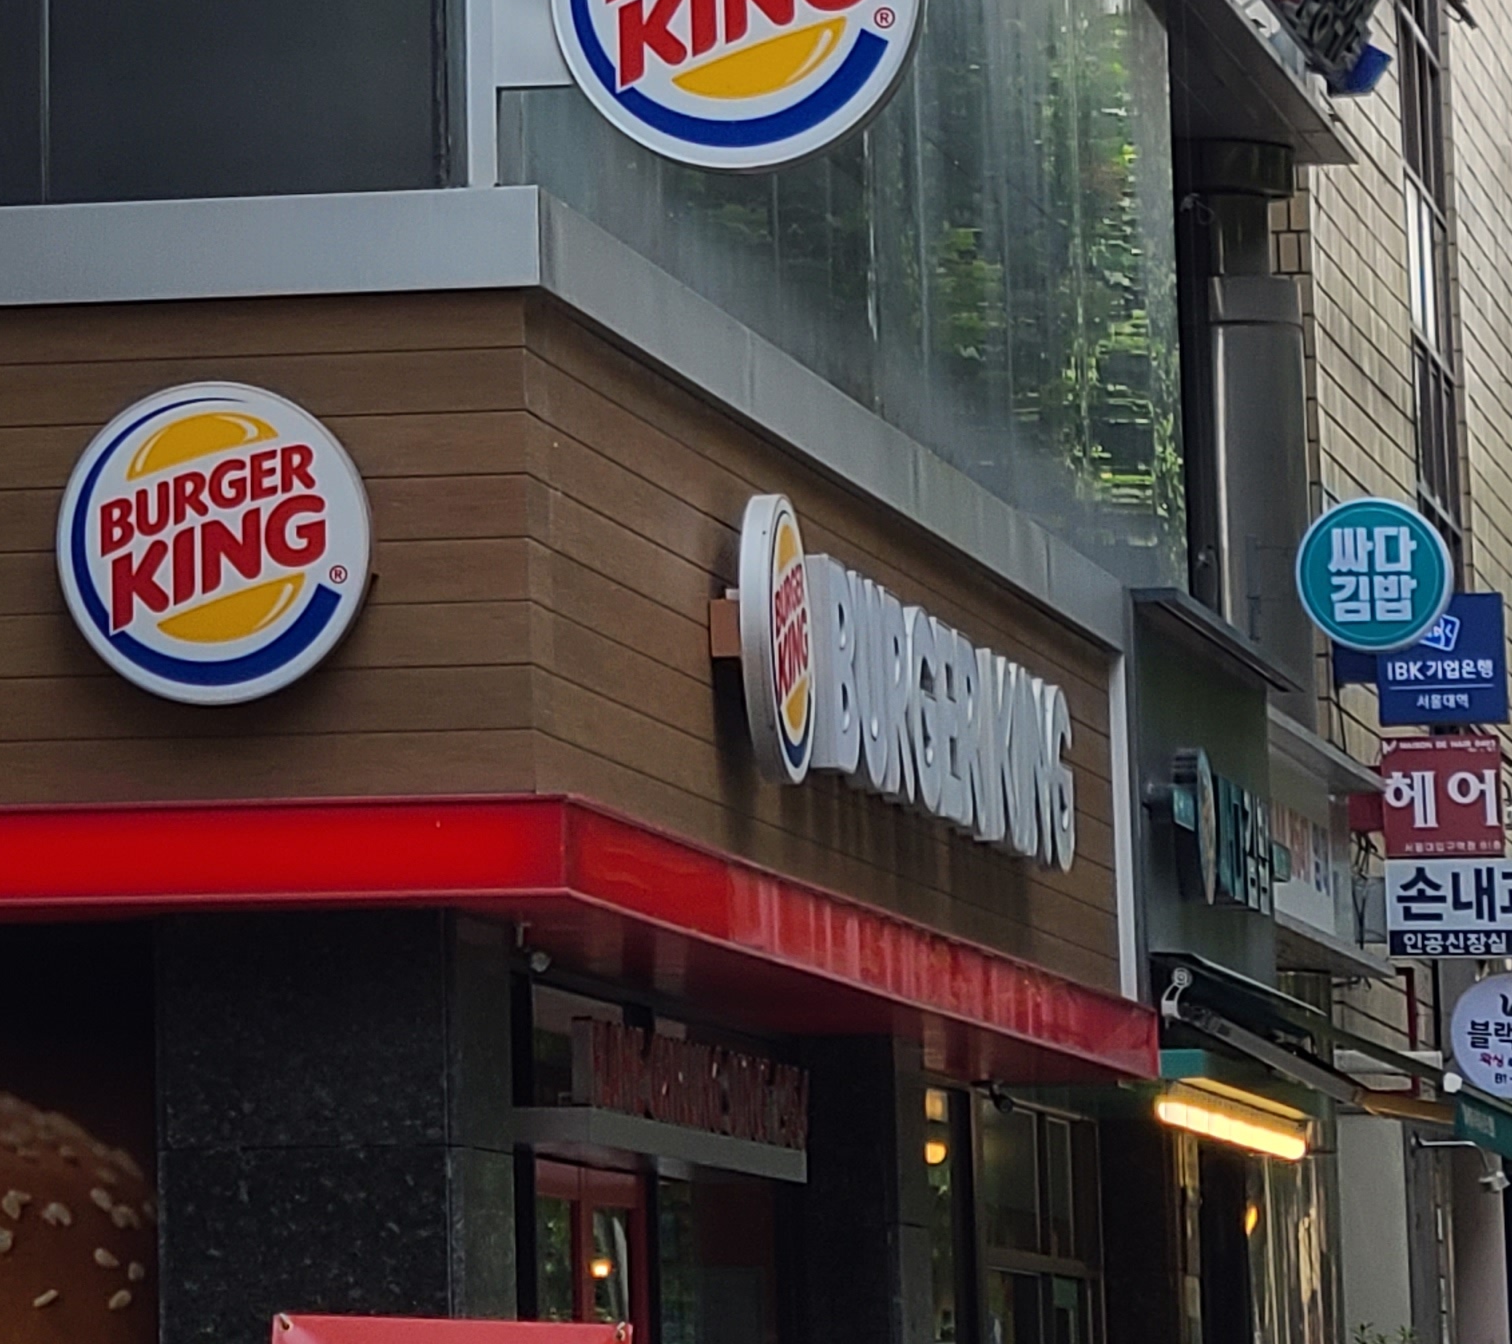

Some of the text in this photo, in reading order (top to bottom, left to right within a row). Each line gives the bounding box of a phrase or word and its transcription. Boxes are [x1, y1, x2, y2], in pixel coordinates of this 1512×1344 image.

[100, 444, 316, 557] BURGER
[112, 494, 326, 632] KING
[1328, 526, 1417, 572] 싸다
[775, 563, 805, 640] BURGER
[1331, 575, 1417, 622] 김밥
[777, 607, 809, 709] KING
[1385, 769, 1500, 828] 헤어
[1396, 866, 1512, 922] 손내
[1403, 932, 1507, 955] 인공신장실
